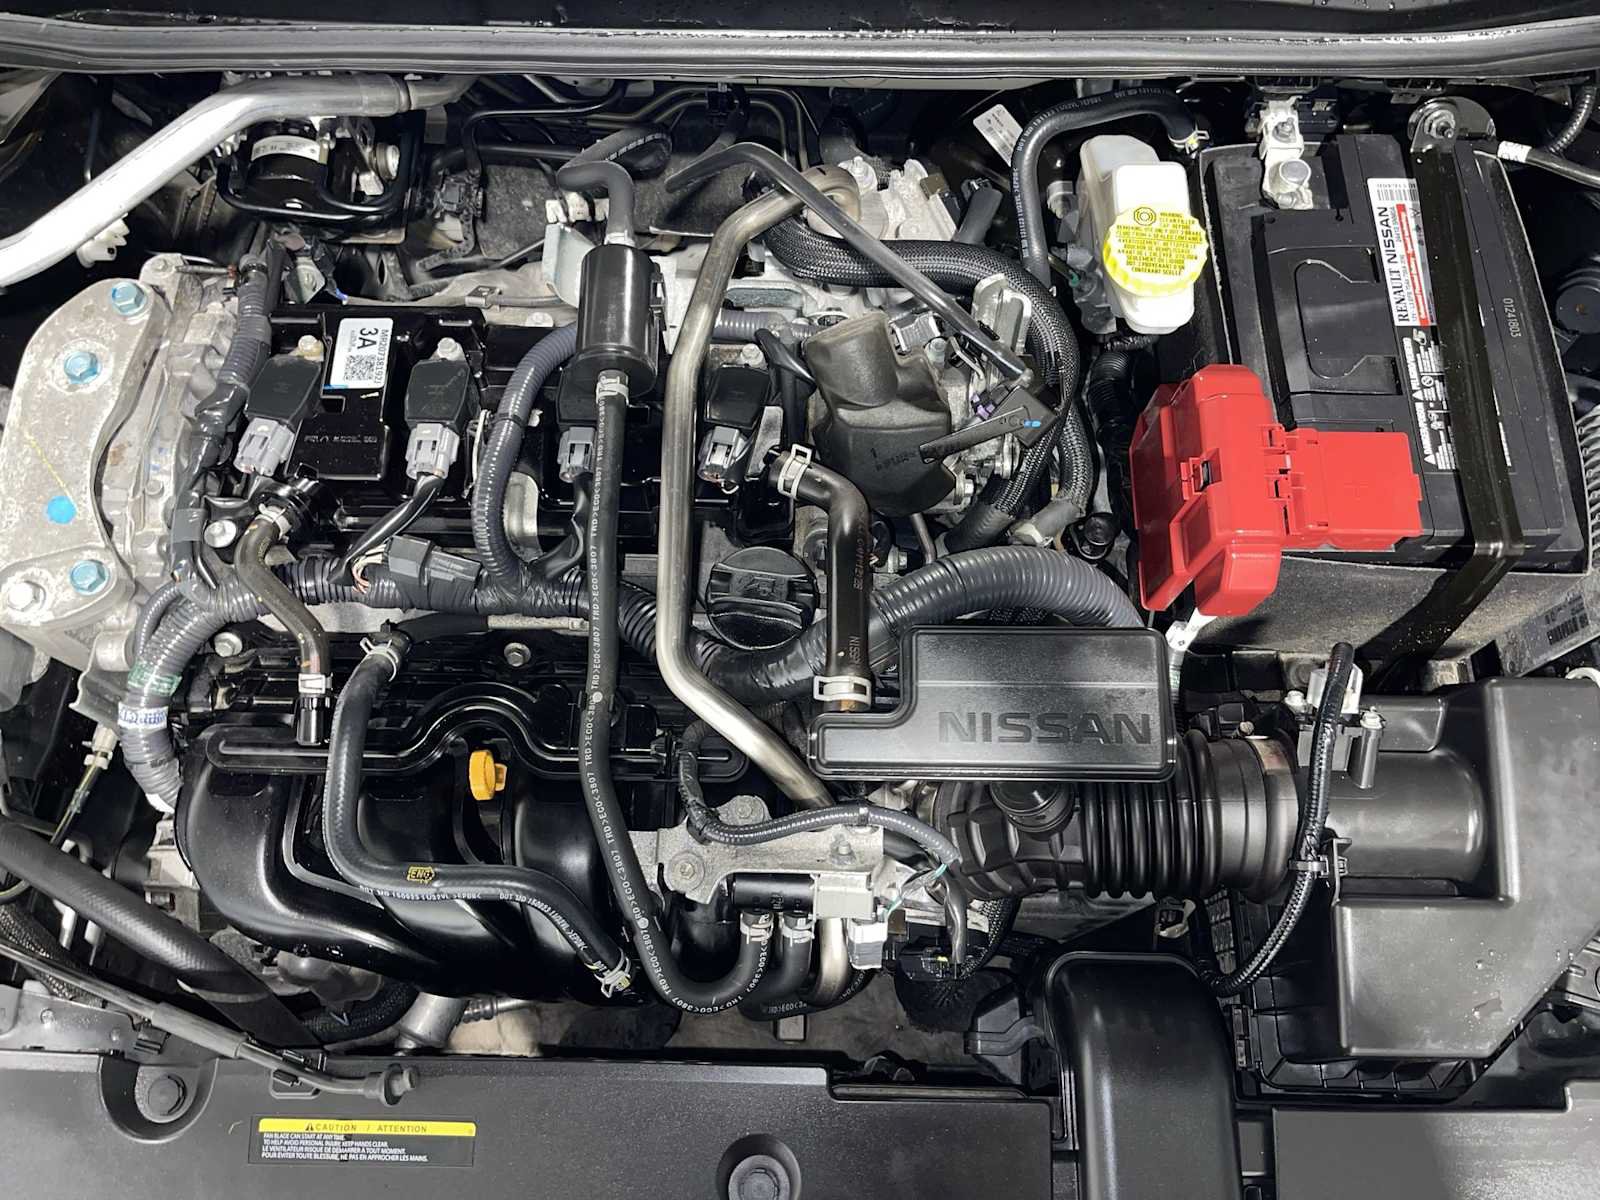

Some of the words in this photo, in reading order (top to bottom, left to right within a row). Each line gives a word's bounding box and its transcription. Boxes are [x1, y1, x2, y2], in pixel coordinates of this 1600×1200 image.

[1377, 206, 1399, 264] NISSAN
[1388, 267, 1410, 322] RENAULT
[1503, 298, 1521, 337] 01241803
[357, 328, 379, 349] 3A
[939, 711, 1151, 744] NISSAN
[585, 772, 615, 845] TRD>ECO<3807
[315, 1123, 357, 1132] CAUTION
[377, 1124, 428, 1133] ATTENTION
